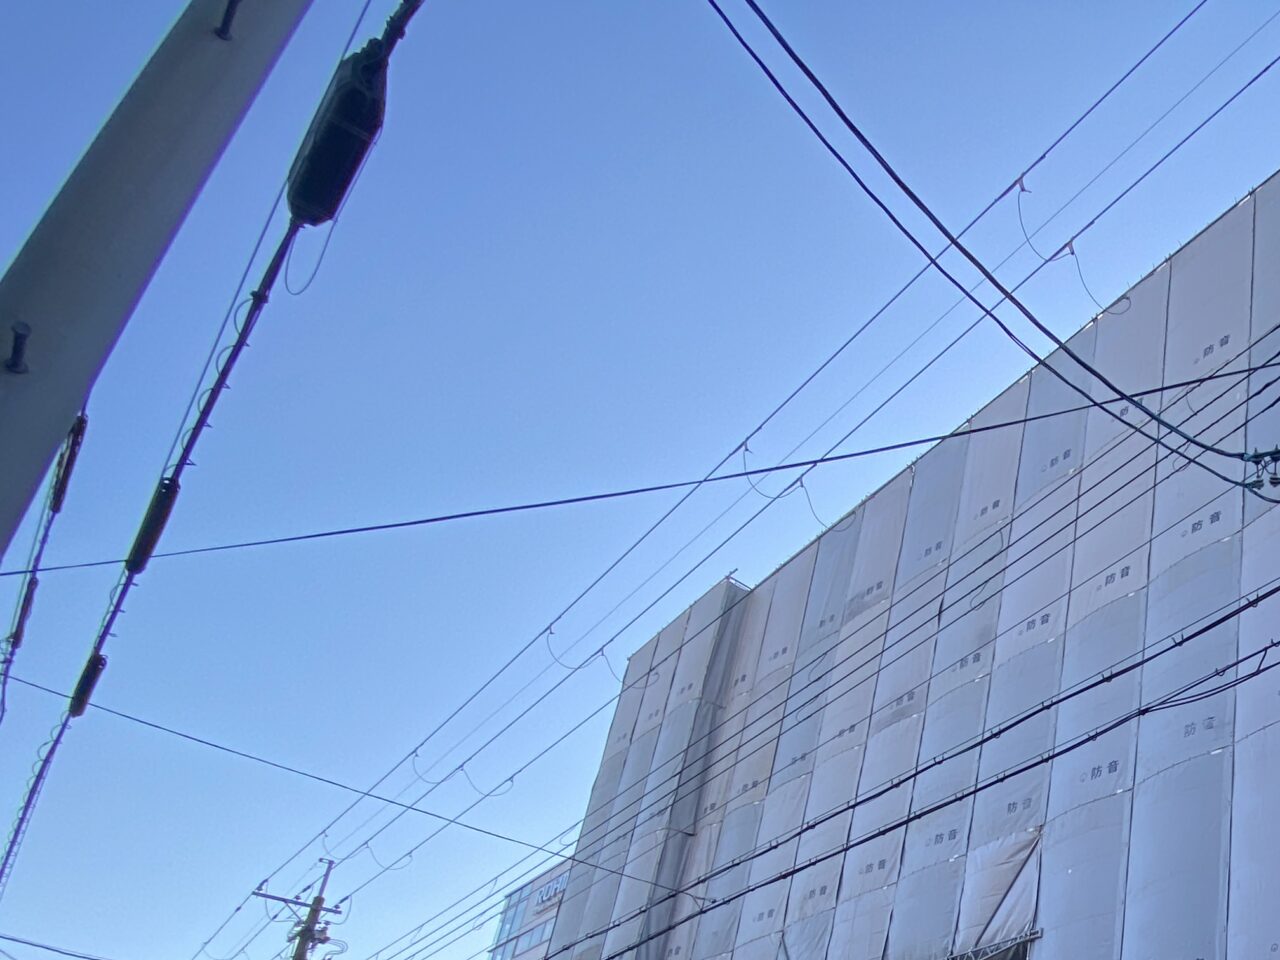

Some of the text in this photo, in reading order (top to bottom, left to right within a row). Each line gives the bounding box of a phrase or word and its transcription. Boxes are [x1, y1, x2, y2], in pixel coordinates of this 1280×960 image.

[1191, 511, 1222, 534] 防音
[1105, 566, 1131, 587] 防音
[1183, 717, 1216, 738] 防音
[1090, 760, 1119, 781] 防音
